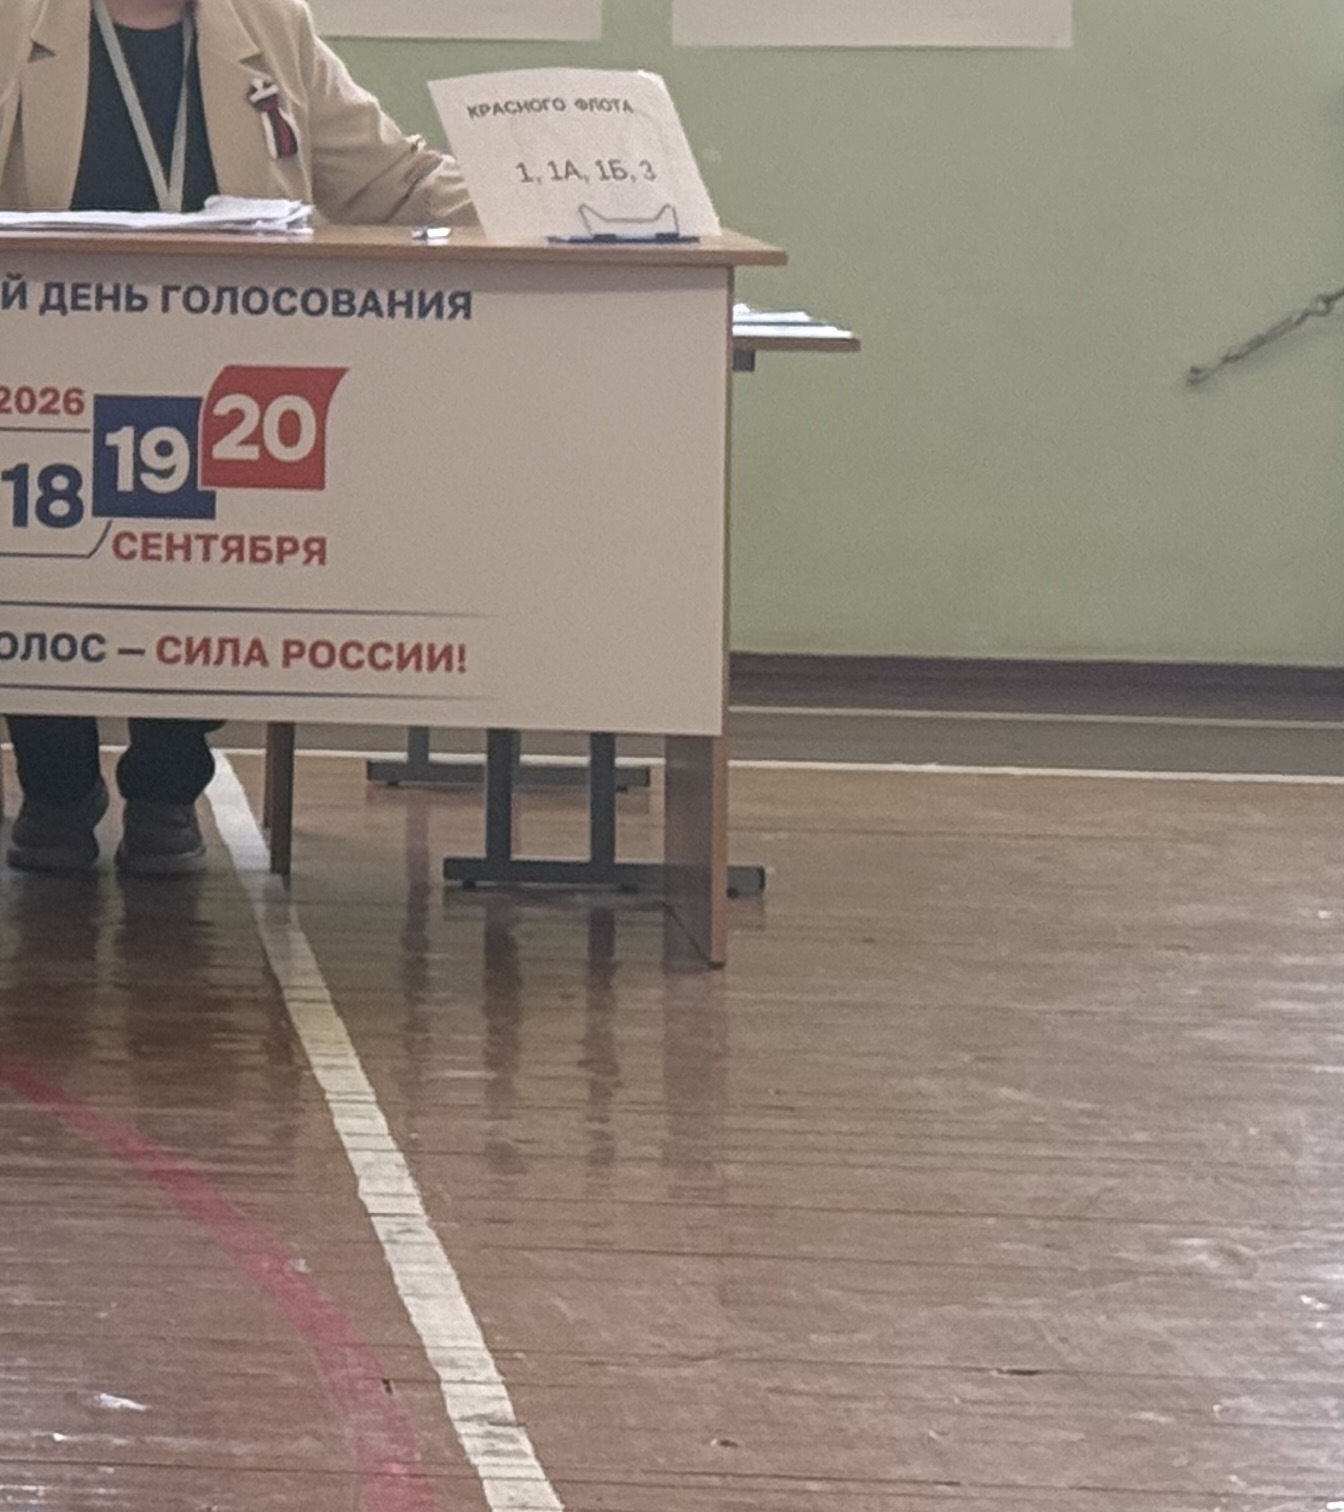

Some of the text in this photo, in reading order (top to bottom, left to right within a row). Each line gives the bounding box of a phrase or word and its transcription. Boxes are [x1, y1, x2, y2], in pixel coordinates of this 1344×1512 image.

[466, 96, 634, 120] КРАСНОГО ФЛОТА
[516, 158, 657, 184] 1, 1А, 1Б, 3
[38, 282, 149, 317] ДЕНЬ
[161, 285, 473, 321] ГОЛОСОВАНИЯ
[212, 393, 317, 463] 20
[105, 425, 191, 494] 19
[1, 462, 85, 529] 18
[111, 530, 328, 566] СЕНТЯБРЯ
[156, 635, 270, 668] СИЛА
[281, 638, 467, 674] РОССИИ!
